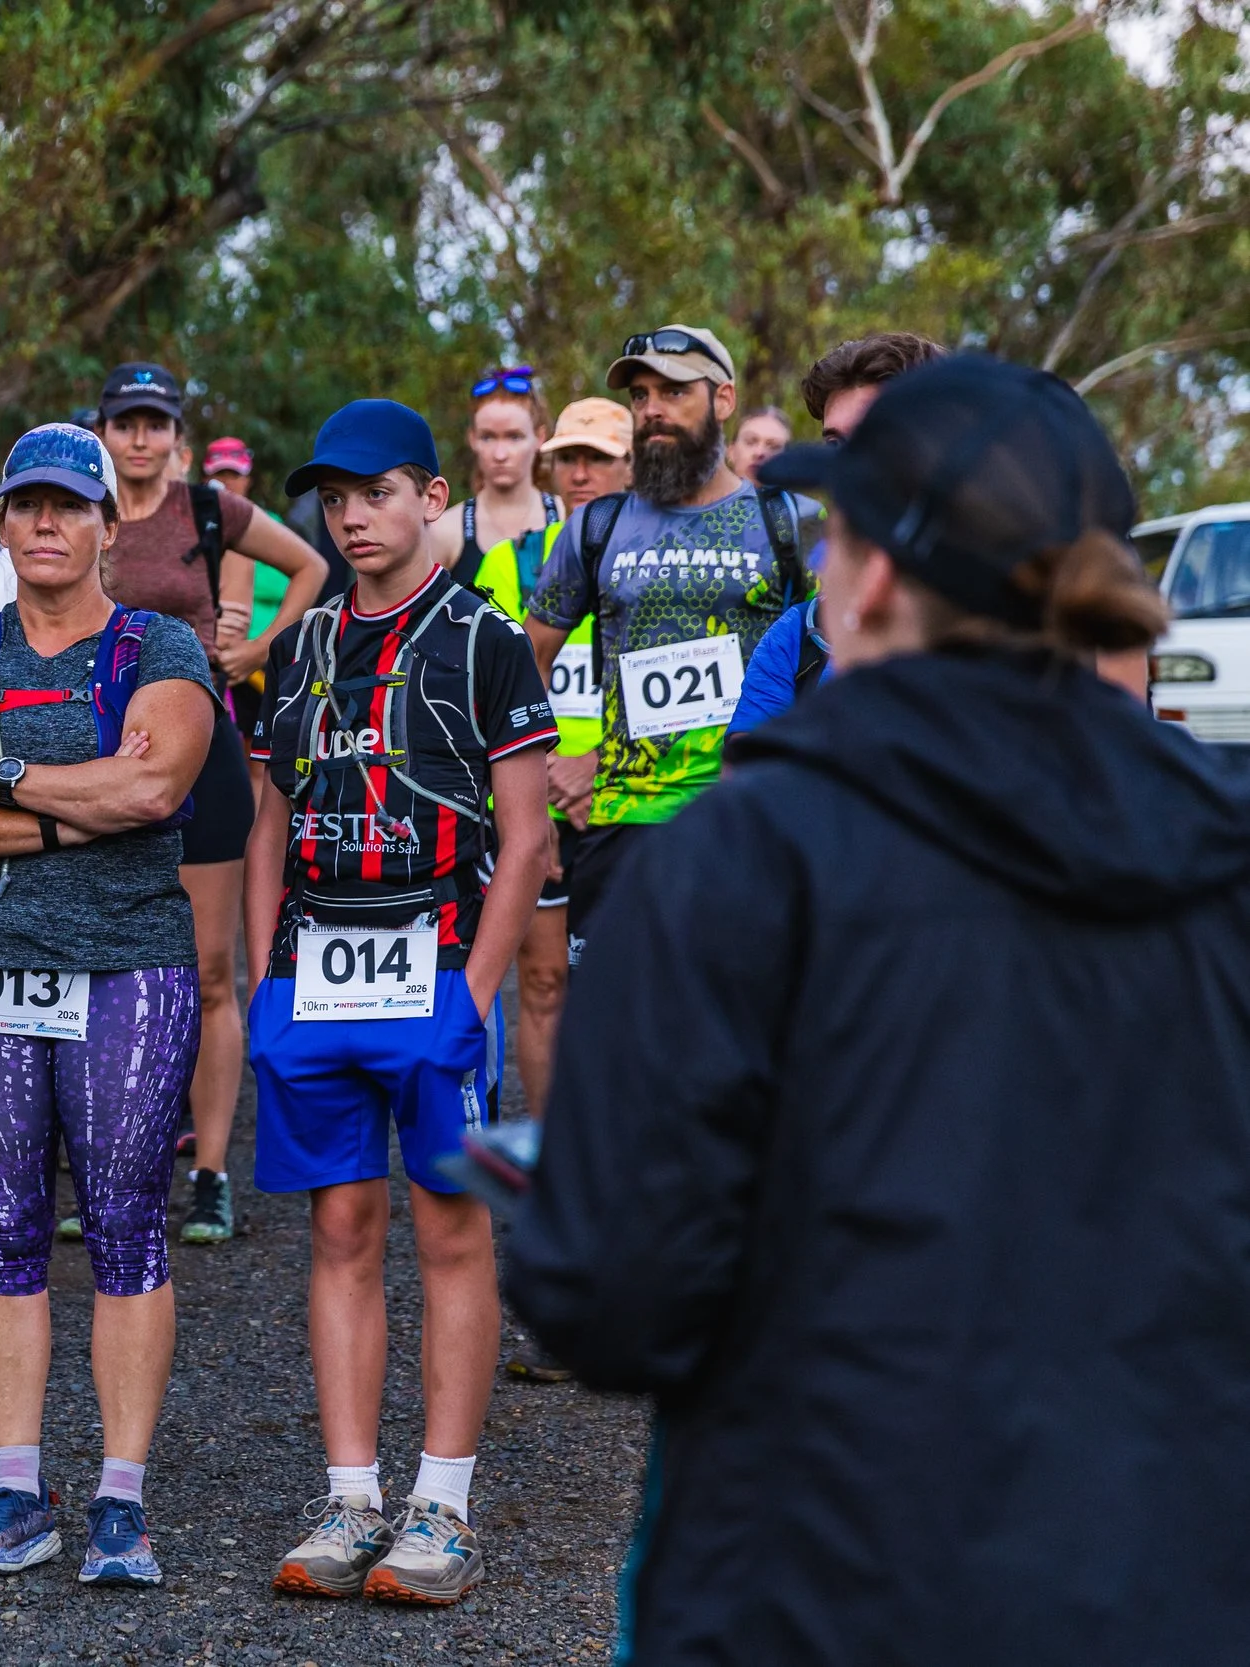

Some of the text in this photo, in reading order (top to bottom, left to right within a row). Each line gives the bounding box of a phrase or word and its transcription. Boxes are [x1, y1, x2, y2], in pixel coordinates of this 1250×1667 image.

[613, 549, 760, 570] MAMMUT
[611, 566, 760, 583] SINCE 1862
[627, 646, 719, 670] Tamworth Trail Blazer
[551, 664, 602, 695] 01
[642, 660, 724, 709] 021
[636, 723, 659, 734] 10km
[342, 840, 396, 853] Solutions
[321, 937, 412, 985] 014
[405, 984, 428, 994] 2026
[301, 1001, 329, 1012] 10km
[339, 1001, 378, 1009] INTERSPORT
[57, 1010, 80, 1021] 2026
